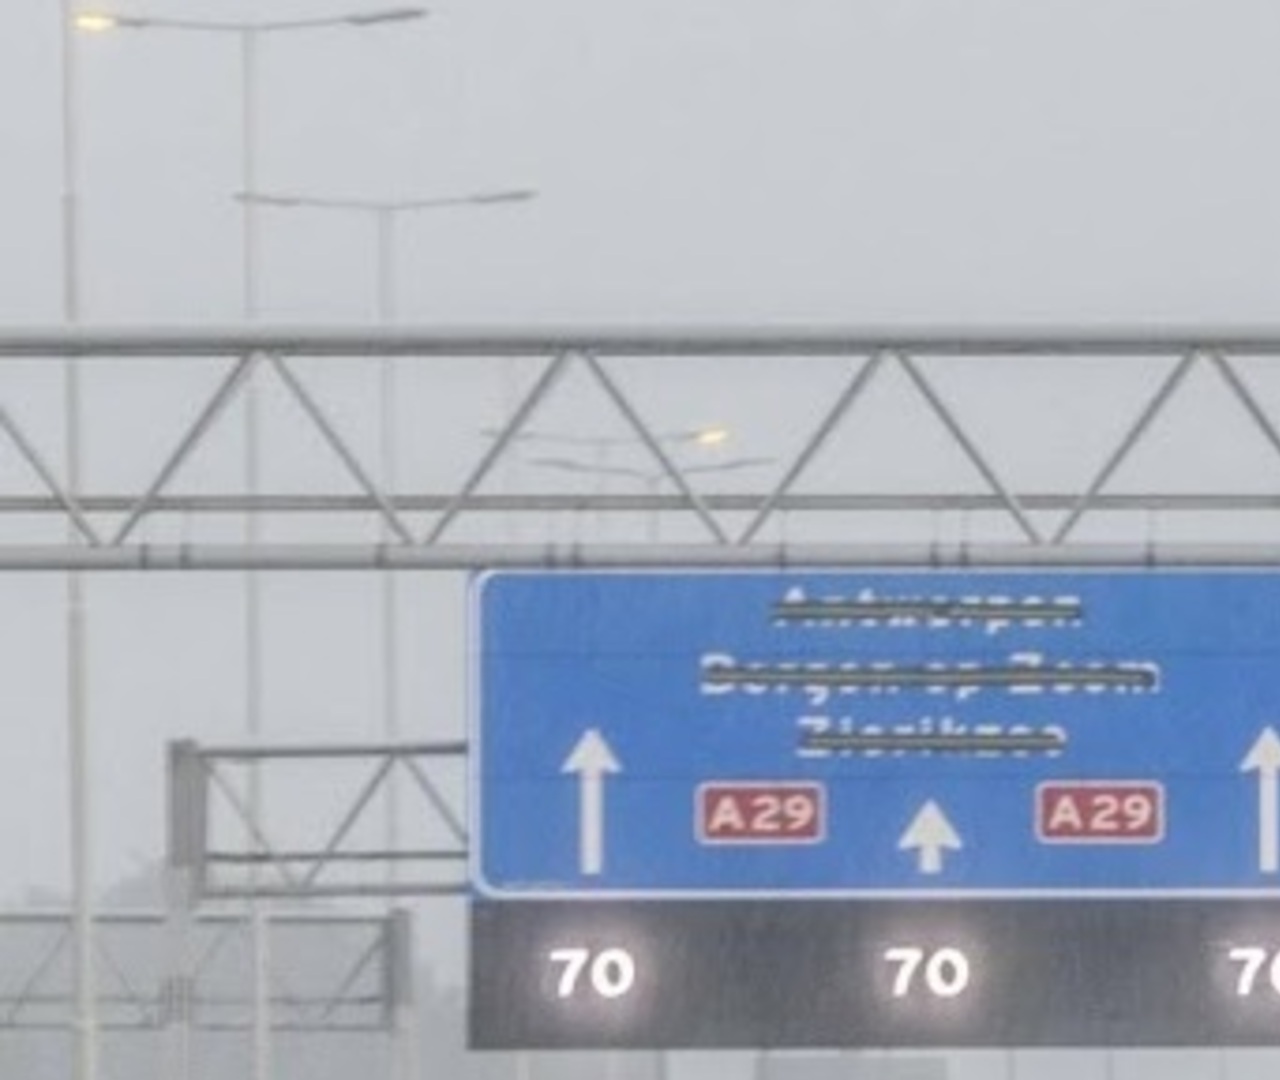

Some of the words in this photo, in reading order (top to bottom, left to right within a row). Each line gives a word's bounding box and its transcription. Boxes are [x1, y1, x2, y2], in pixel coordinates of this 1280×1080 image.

[707, 795, 815, 833] A29
[1047, 795, 1154, 833] A29
[549, 947, 635, 998] 70
[884, 947, 971, 998] 70
